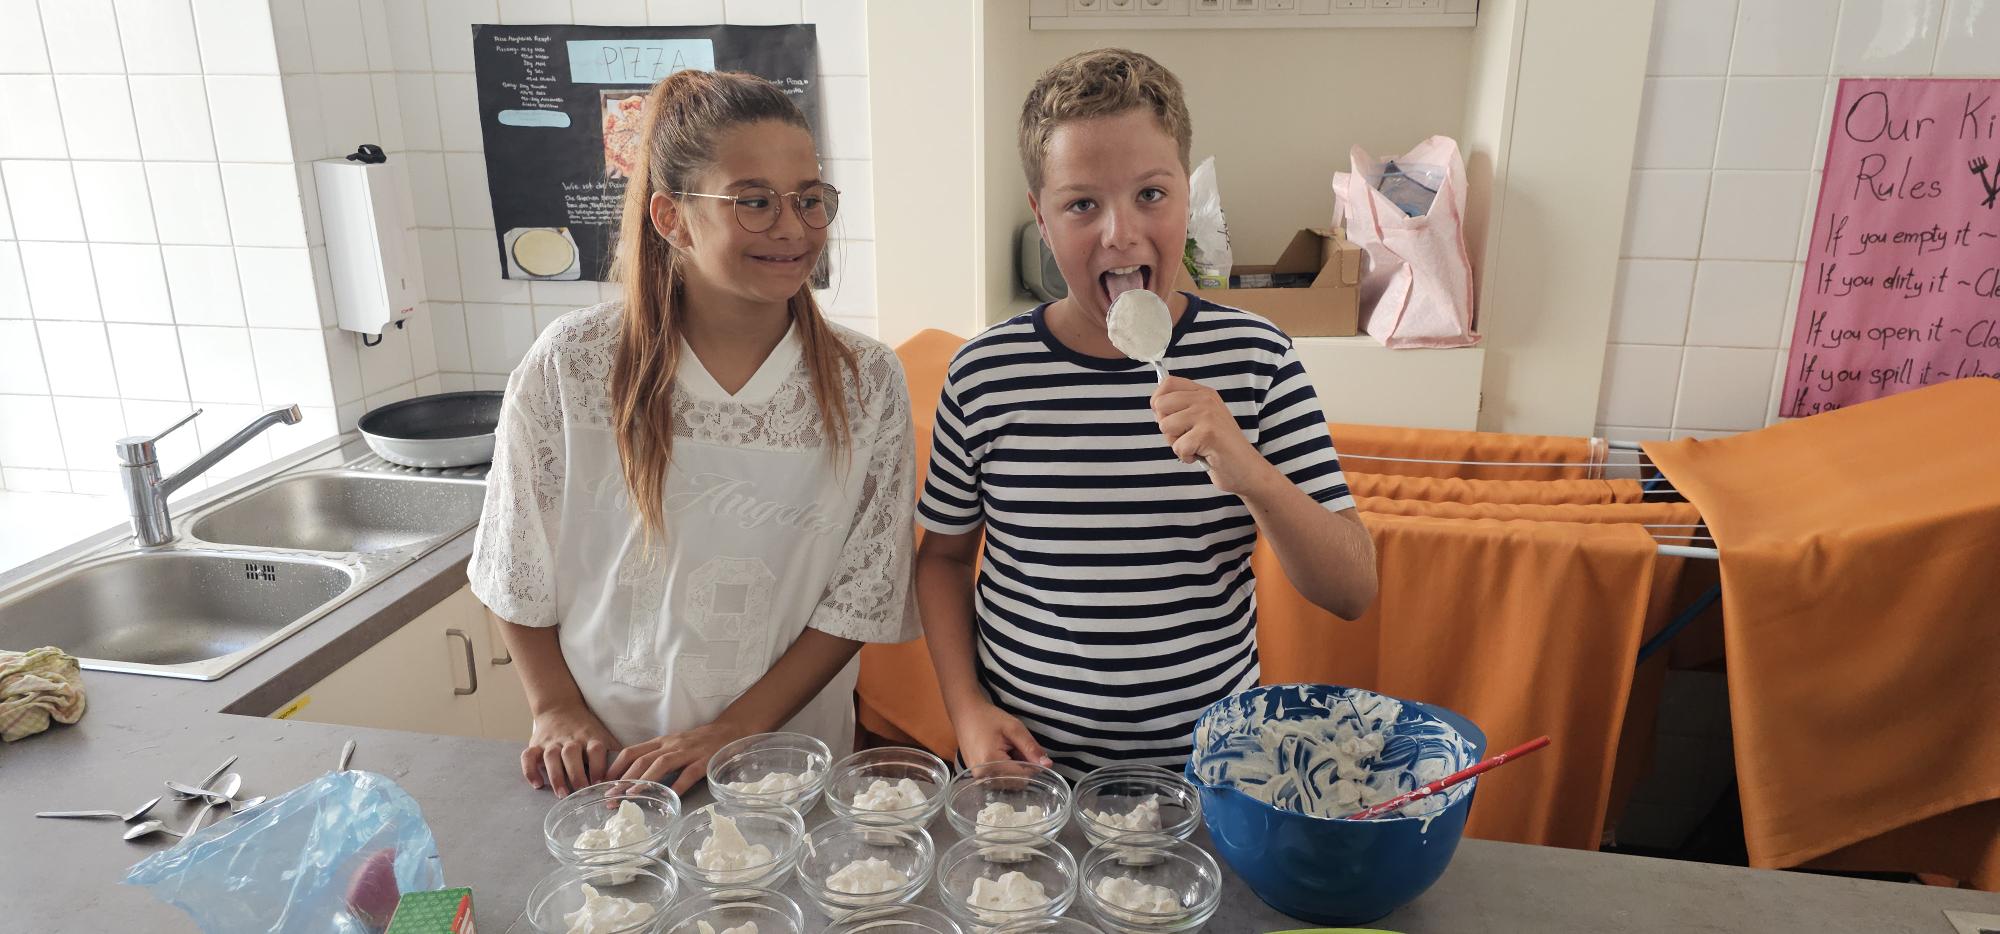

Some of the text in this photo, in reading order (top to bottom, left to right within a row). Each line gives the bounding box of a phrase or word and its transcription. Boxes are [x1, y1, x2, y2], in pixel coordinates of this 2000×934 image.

[602, 46, 687, 81] PIZZA
[1845, 91, 2000, 142] Our Ki
[1853, 153, 1942, 201] Rules
[1825, 213, 1849, 257] If
[1848, 233, 1887, 256] you
[1893, 223, 1948, 256] empty
[1954, 221, 1971, 247] it
[1817, 262, 1837, 295] If
[1833, 275, 1874, 297] you
[1882, 266, 1922, 299] dirty
[1928, 267, 1948, 293] it
[1974, 267, 2000, 298] Cle
[1806, 310, 1828, 348] If
[1821, 329, 1861, 349] you
[1867, 327, 1921, 351] open
[1928, 317, 1943, 342] it
[1965, 319, 2000, 348] Clo
[1799, 352, 1818, 384] If
[1818, 368, 1861, 392] you
[1869, 358, 1914, 391] spill
[1920, 361, 1933, 385] it
[1791, 386, 1809, 417] If
[584, 472, 843, 536] Lo Angeles
[612, 546, 776, 699] 19
